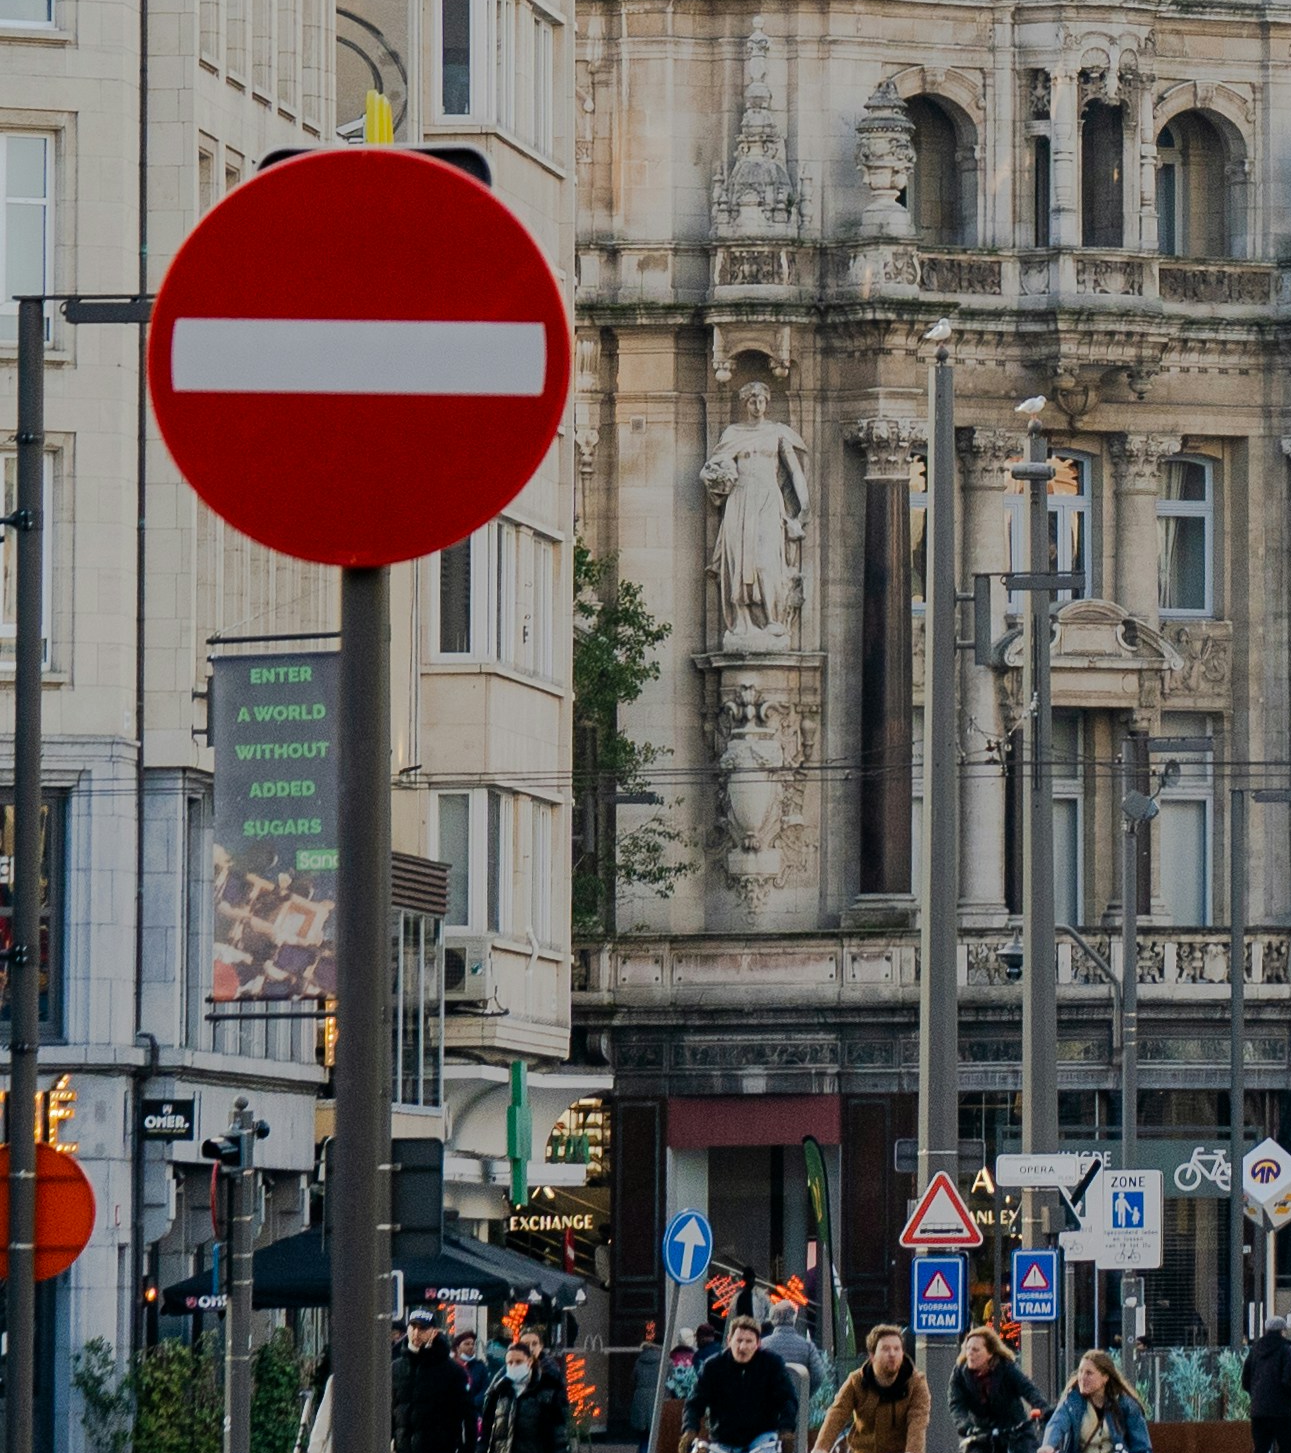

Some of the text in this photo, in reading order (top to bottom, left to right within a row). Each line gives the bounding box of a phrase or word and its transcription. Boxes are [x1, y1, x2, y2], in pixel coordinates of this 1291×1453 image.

[251, 667, 312, 683] ENTER
[237, 704, 325, 722] A WORLD
[235, 742, 329, 760] WITHOUT
[250, 781, 316, 796] ADDED
[243, 818, 322, 836] SUGARS
[1019, 1166, 1056, 1175] OPERA
[1111, 1176, 1145, 1188] ZONE
[510, 1214, 593, 1231] EXCHANGE
[918, 1303, 959, 1312] VOORRANG
[1018, 1302, 1051, 1315] TRAM
[920, 1314, 957, 1327] TRAM
